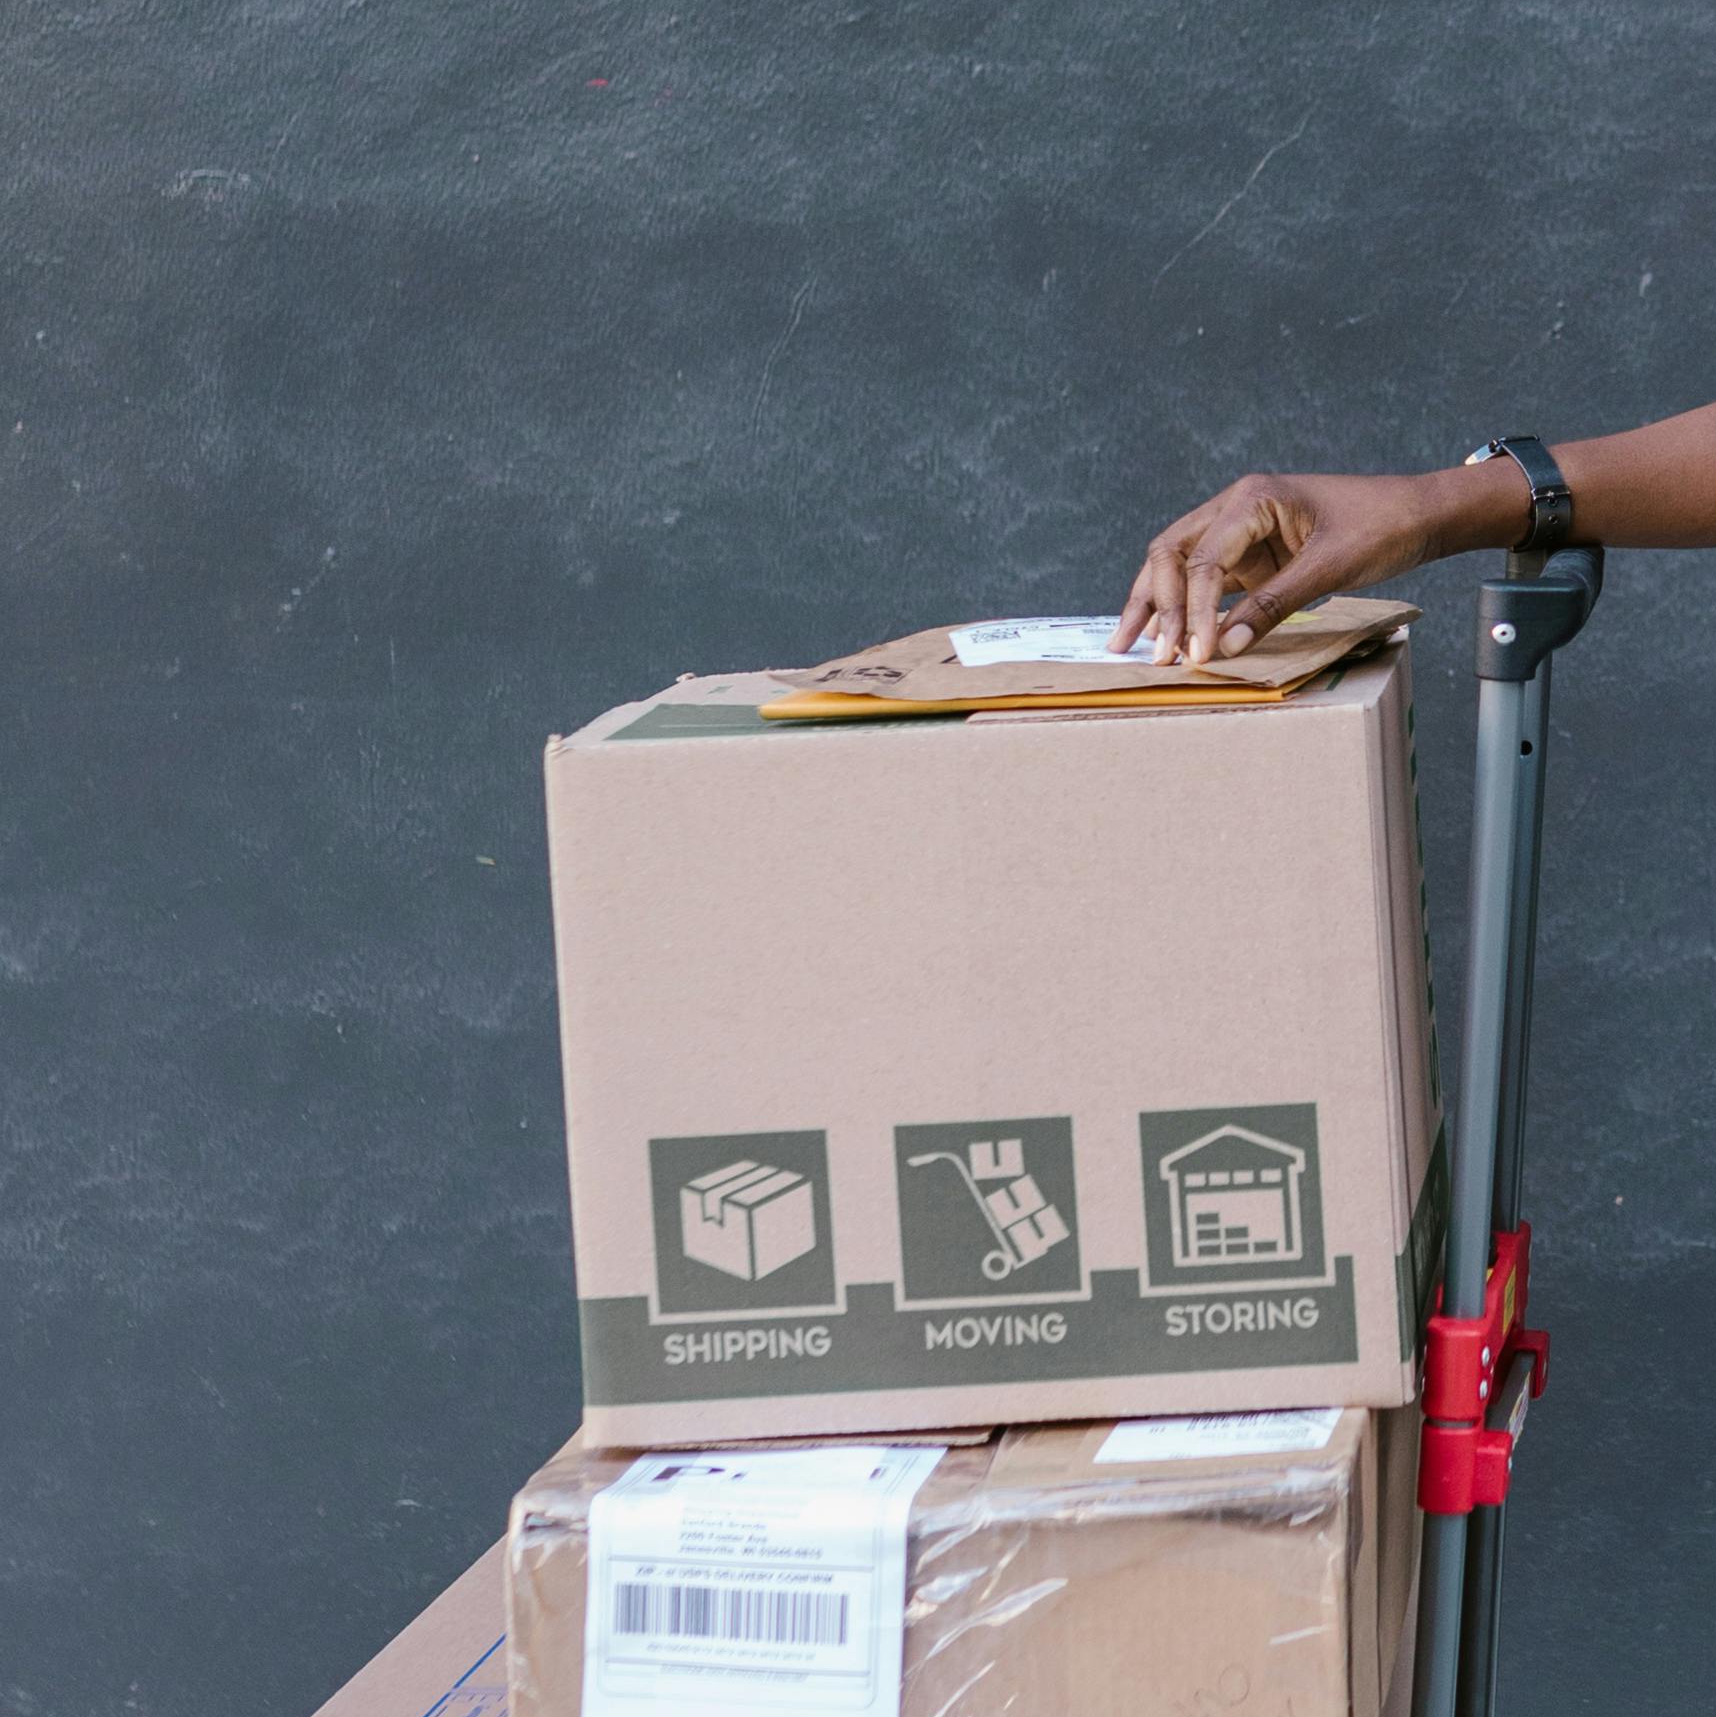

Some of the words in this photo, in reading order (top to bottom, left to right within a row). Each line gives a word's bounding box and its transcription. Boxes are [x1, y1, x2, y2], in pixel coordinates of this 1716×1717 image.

[924, 1312, 1068, 1351] MOVING
[1164, 1297, 1320, 1337] STORING
[663, 1326, 832, 1366] SHIPPING
